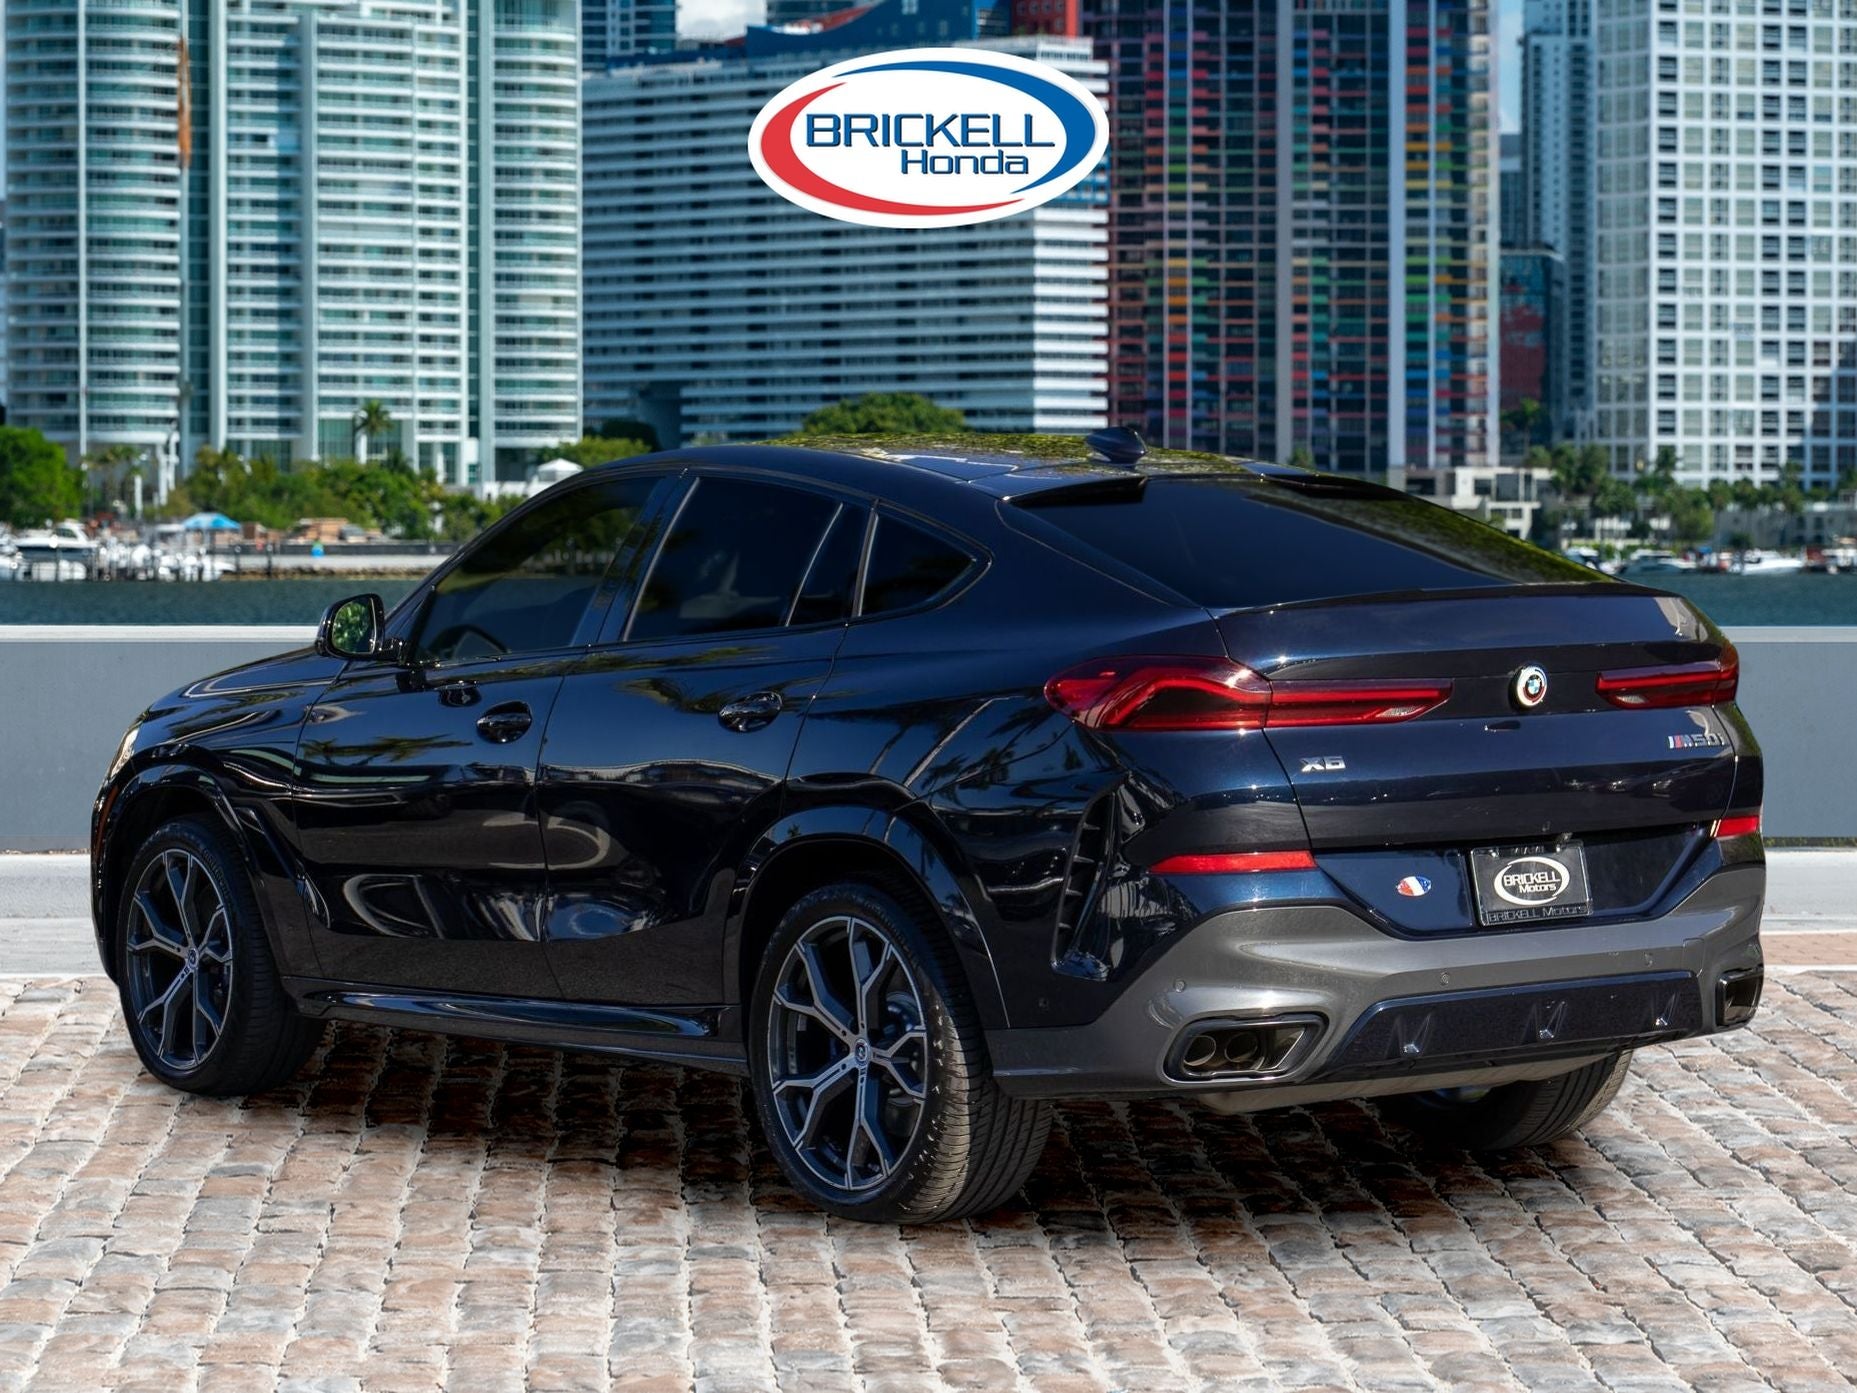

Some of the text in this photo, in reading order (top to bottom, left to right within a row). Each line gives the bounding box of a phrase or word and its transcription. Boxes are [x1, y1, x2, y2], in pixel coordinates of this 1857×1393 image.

[1300, 756, 1346, 772] X6
[1503, 871, 1560, 887] BRICKELL
[1519, 883, 1556, 893] Motors
[1489, 904, 1587, 922] BRICKELL Motors
